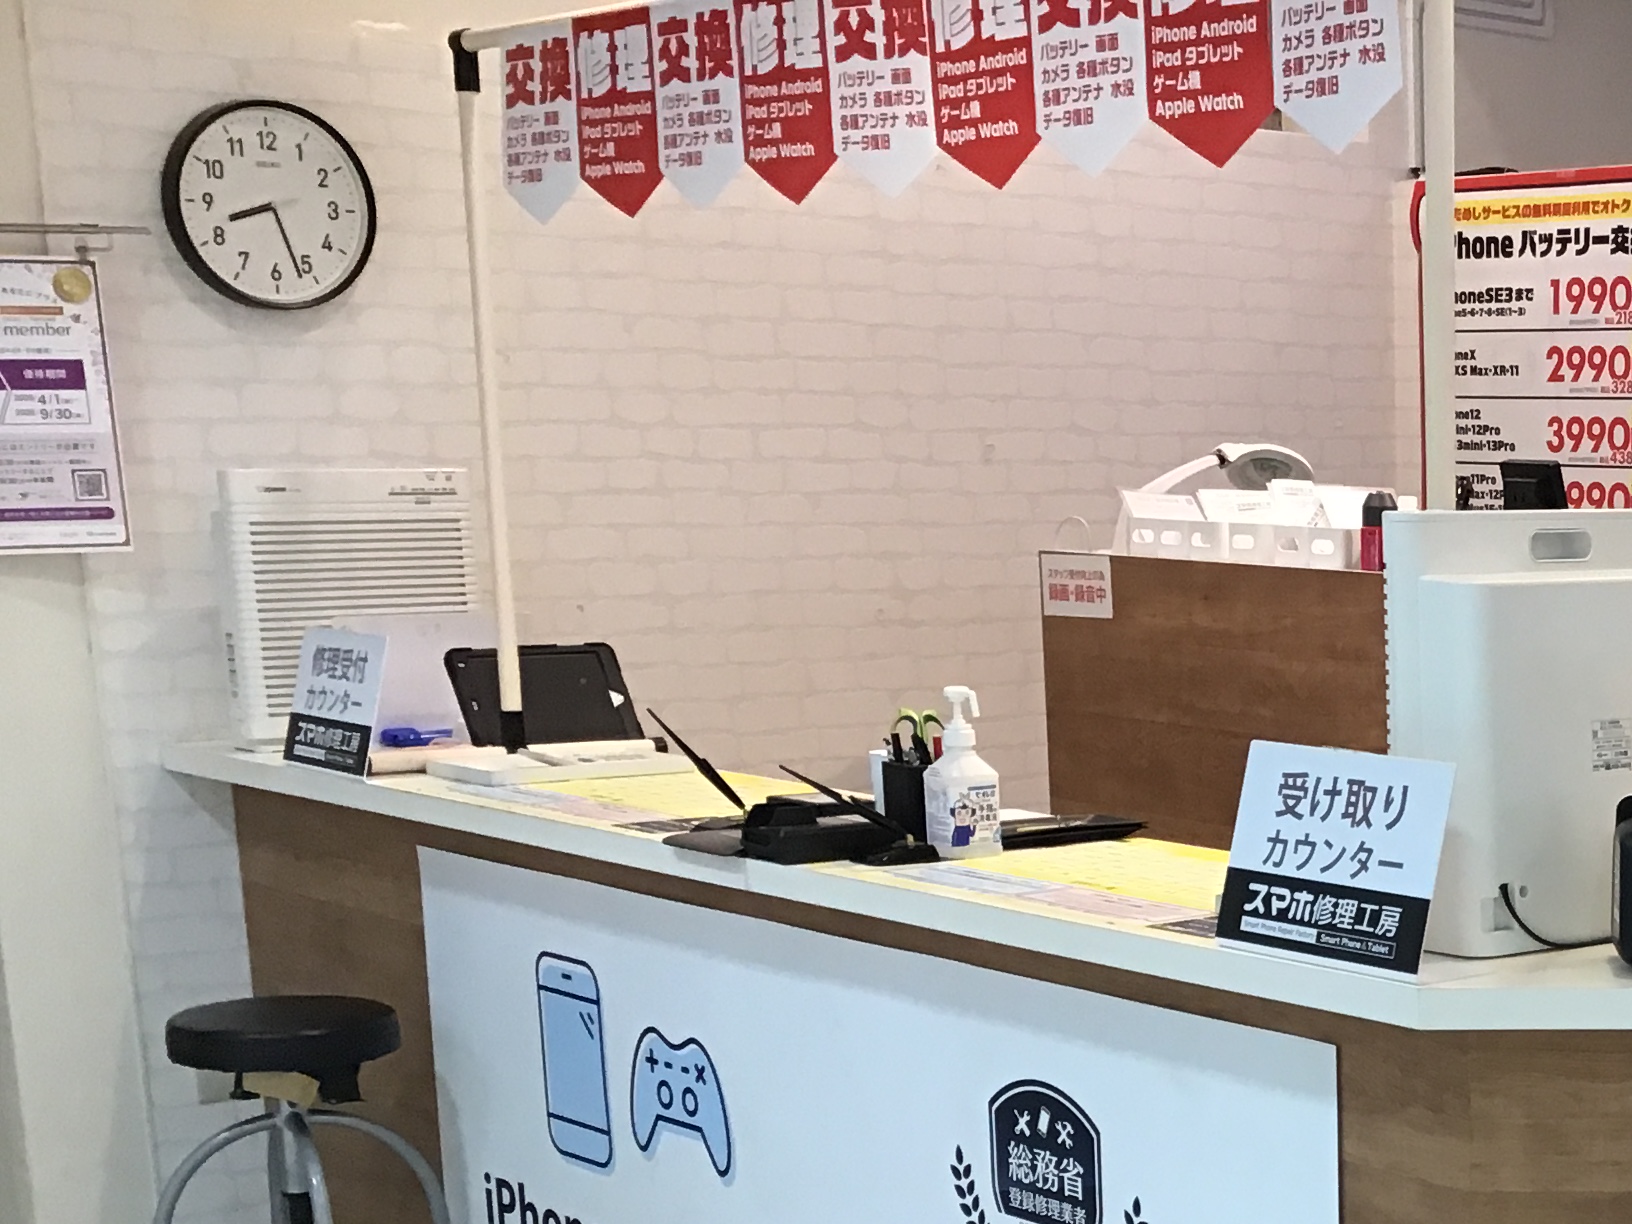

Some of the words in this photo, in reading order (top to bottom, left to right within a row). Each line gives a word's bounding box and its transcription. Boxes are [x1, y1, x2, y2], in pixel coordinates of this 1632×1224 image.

[1281, 1, 1336, 27] バッテリー
[740, 0, 823, 76] 修理
[1151, 24, 1196, 44] iPhone
[1201, 15, 1256, 38] Android
[657, 9, 734, 87] 交換
[1041, 39, 1089, 61] バッテリー
[1282, 29, 1314, 53] カメラ
[577, 24, 652, 99] 修理
[937, 59, 976, 78] iPhone
[979, 48, 1026, 71] Android
[1152, 49, 1181, 68] iPad
[506, 37, 572, 109] 交換
[1041, 64, 1070, 84] カメラ
[839, 92, 867, 110] カメラ
[938, 83, 964, 100] iPad
[1155, 98, 1195, 119] Apple
[1198, 93, 1244, 113] Watch
[256, 131, 277, 151] 12
[942, 126, 976, 146] Apple
[978, 120, 1019, 140] Watch
[227, 138, 244, 157] 11
[295, 143, 303, 161] 1
[203, 160, 224, 180] 10
[317, 169, 329, 188] 2
[202, 192, 213, 210] 9
[327, 202, 339, 220] 3
[213, 227, 226, 245] 8
[322, 234, 333, 251] 4
[1454, 231, 1513, 259] hone
[239, 252, 250, 270] 7
[301, 256, 313, 275] 5
[271, 264, 282, 281] 6
[4, 323, 72, 336] member
[305, 685, 362, 714] カウンター
[1275, 772, 1409, 830] 受け取り
[1262, 829, 1404, 880] カウンター
[1243, 883, 1403, 938] スマホ修理工房
[1320, 934, 1340, 944] Smart
[1342, 938, 1361, 949] Phone
[1007, 1141, 1084, 1201] 総務省
